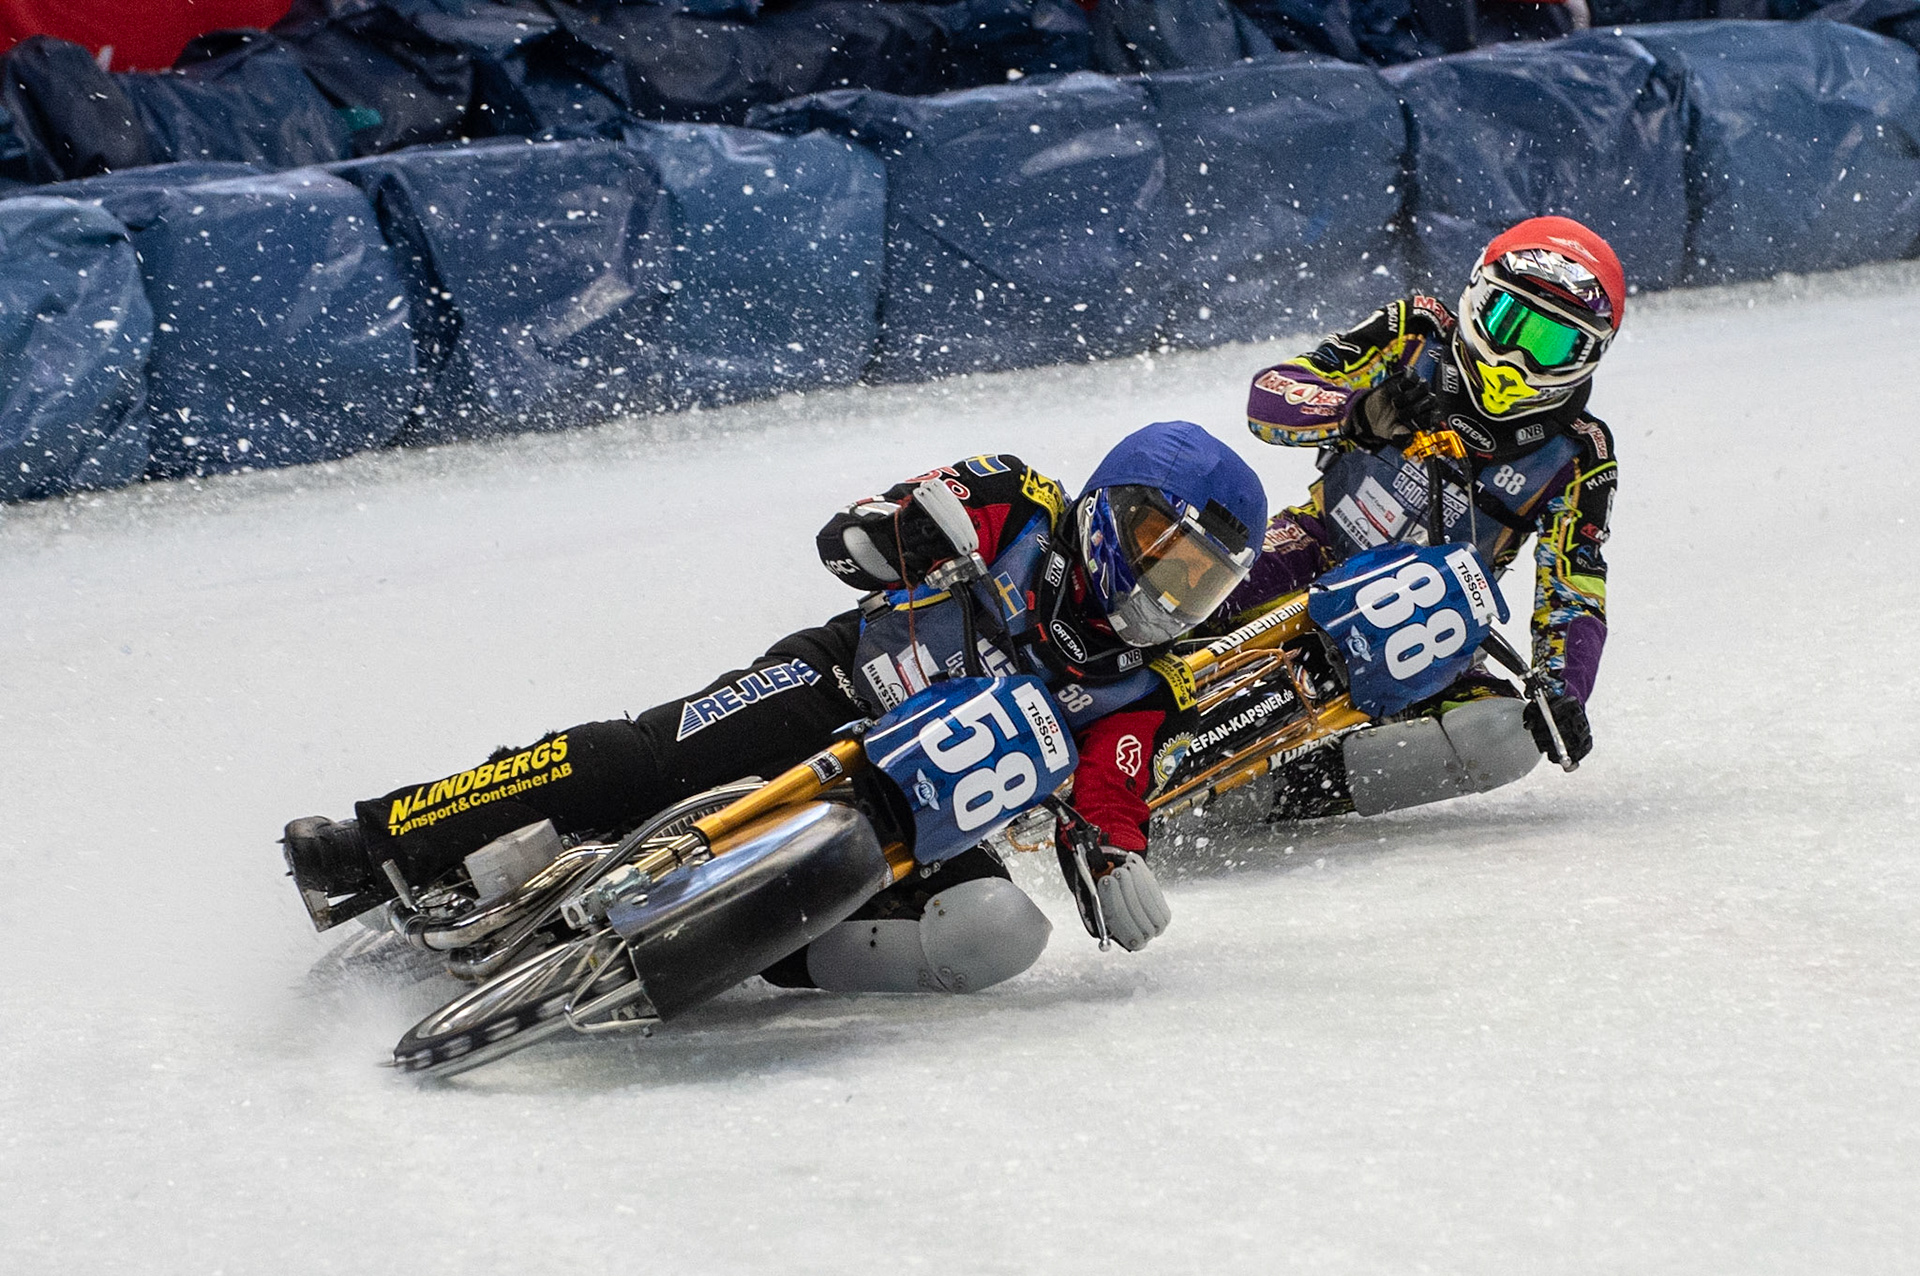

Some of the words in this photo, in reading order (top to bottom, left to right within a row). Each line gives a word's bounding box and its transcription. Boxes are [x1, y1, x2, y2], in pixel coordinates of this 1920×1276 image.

[1451, 418, 1492, 449] ORTEMA
[1493, 464, 1526, 495] 88
[1457, 561, 1485, 608] TISSOT
[1355, 562, 1467, 680] 88
[1052, 623, 1084, 660] ORTEMA
[1058, 683, 1093, 713] 58
[1027, 702, 1057, 755] TISSOT
[551, 762, 573, 782] AB
[919, 690, 1038, 832] 58
